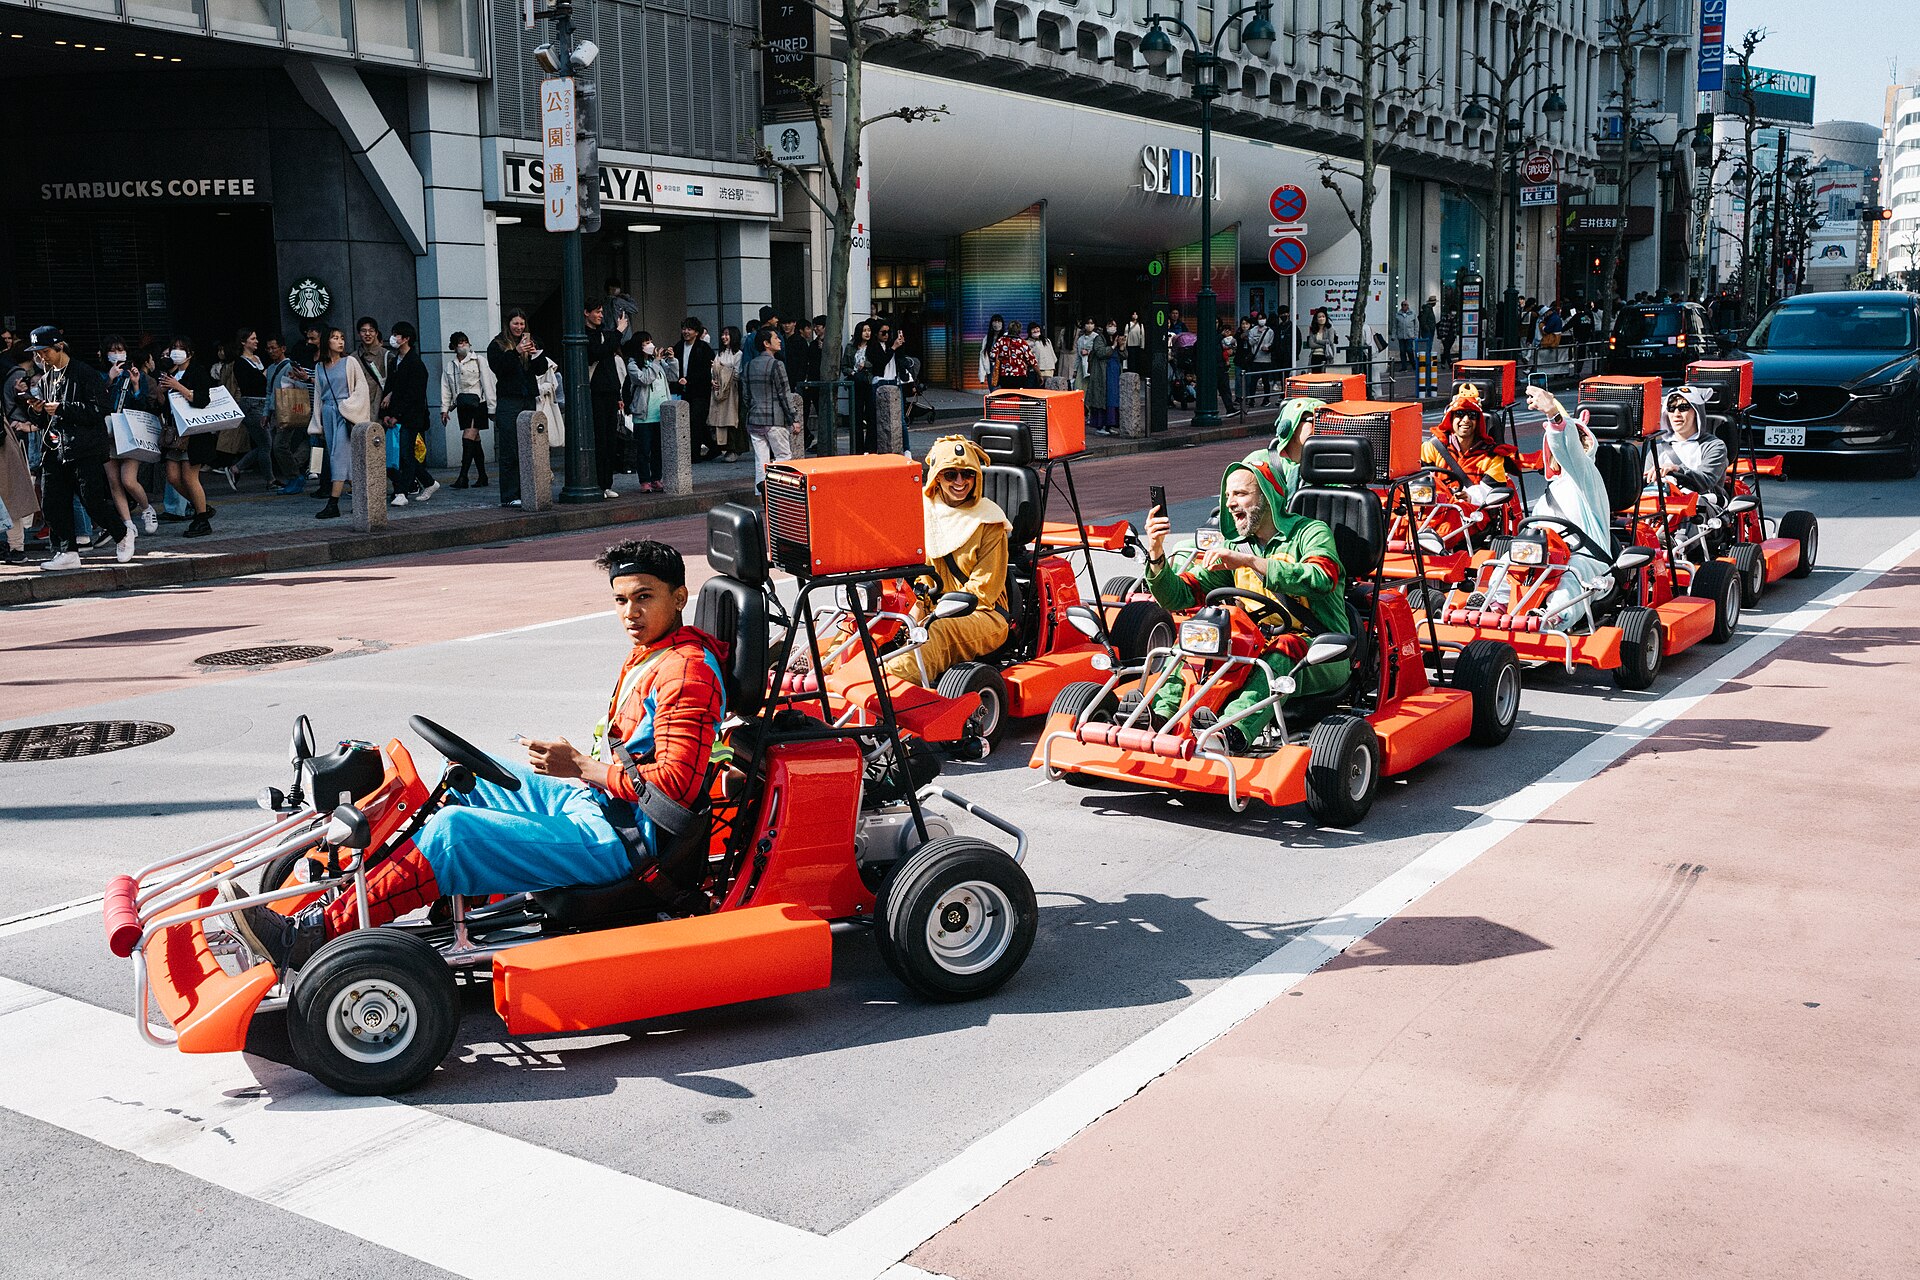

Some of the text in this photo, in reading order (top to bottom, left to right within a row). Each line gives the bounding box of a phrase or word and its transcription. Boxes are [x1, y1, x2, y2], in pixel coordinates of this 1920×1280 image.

[781, 6, 794, 17] 7F
[769, 36, 808, 53] WIRED
[1701, 0, 1723, 73] SEIBU
[774, 53, 804, 64] TOKYO
[1770, 72, 1809, 94] NITORI
[546, 91, 565, 218] 公園通り
[506, 157, 652, 202] TSAYA
[41, 179, 255, 200] STARBUCKS COFFEE
[719, 187, 744, 201] 渋谷駅
[1525, 192, 1552, 200] KEN
[1310, 279, 1326, 287] GO!
[185, 409, 243, 426] MUSINSA
[1773, 434, 1803, 445] 52-82
